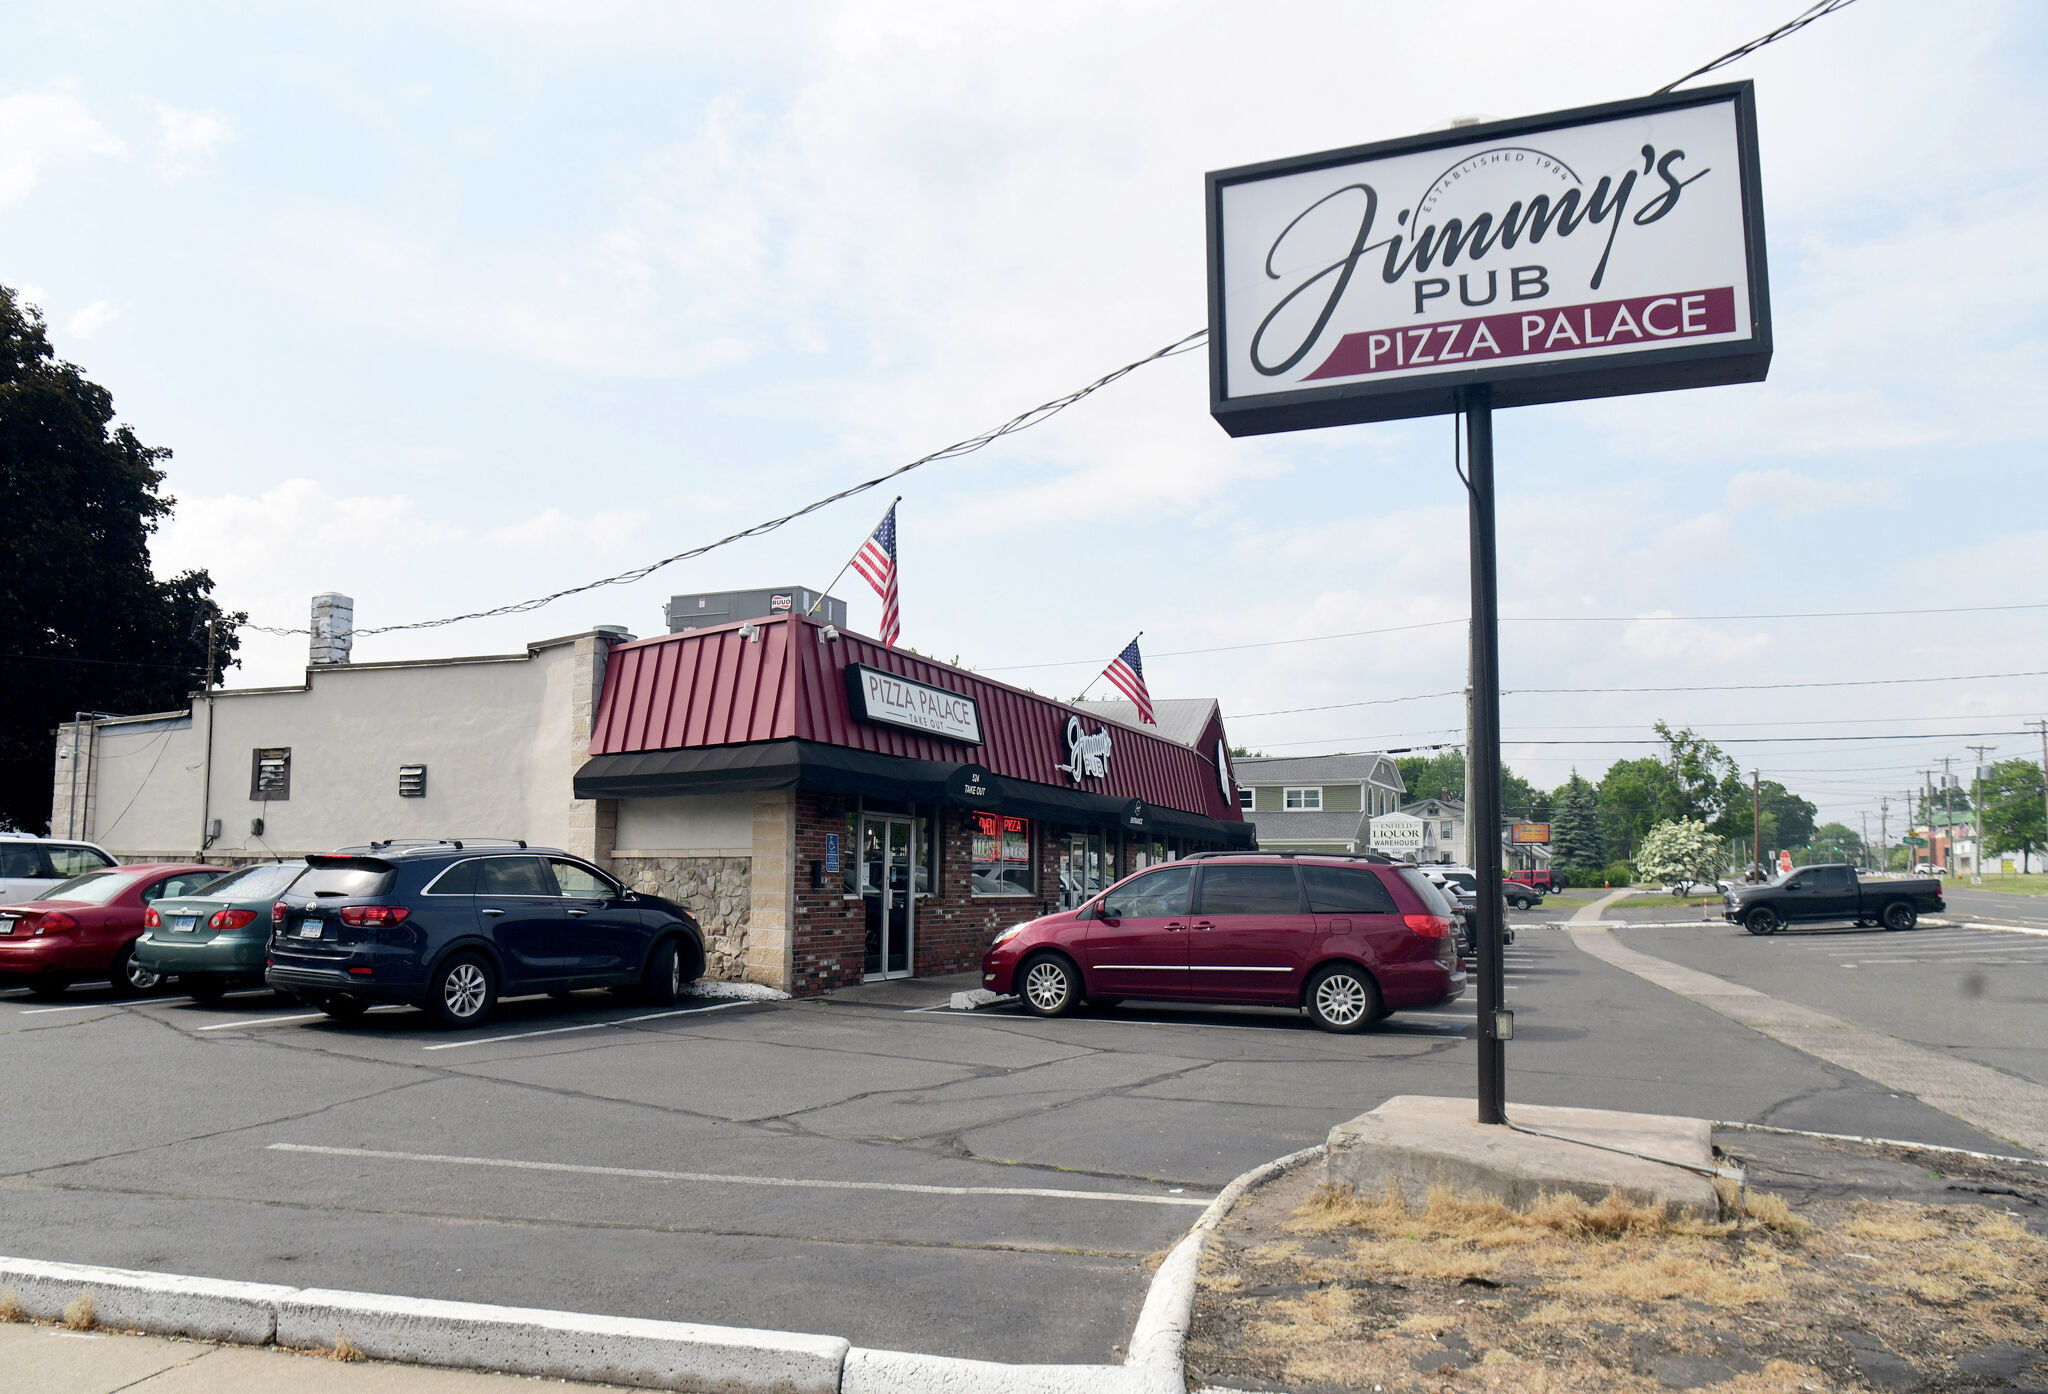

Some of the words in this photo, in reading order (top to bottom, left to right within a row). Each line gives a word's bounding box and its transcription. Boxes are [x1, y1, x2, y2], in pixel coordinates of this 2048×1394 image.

[1423, 153, 1525, 213] ESTABLISHED
[1535, 157, 1569, 181] 1984
[1249, 143, 1712, 377] Jimmy's
[1413, 264, 1550, 315] PUB
[1368, 319, 1502, 370] PIZZA
[1521, 294, 1708, 352] PALACE
[772, 598, 791, 606] RUUD
[868, 675, 917, 712] PIZZA
[918, 689, 971, 726] PALACE
[908, 713, 928, 727] TAKE
[930, 720, 945, 731] OUT
[1085, 757, 1105, 778] PUB
[965, 784, 976, 795] TAKE
[976, 786, 986, 796] OUT
[1003, 819, 1022, 832] PIZZA
[1373, 830, 1420, 839] LIQUOR
